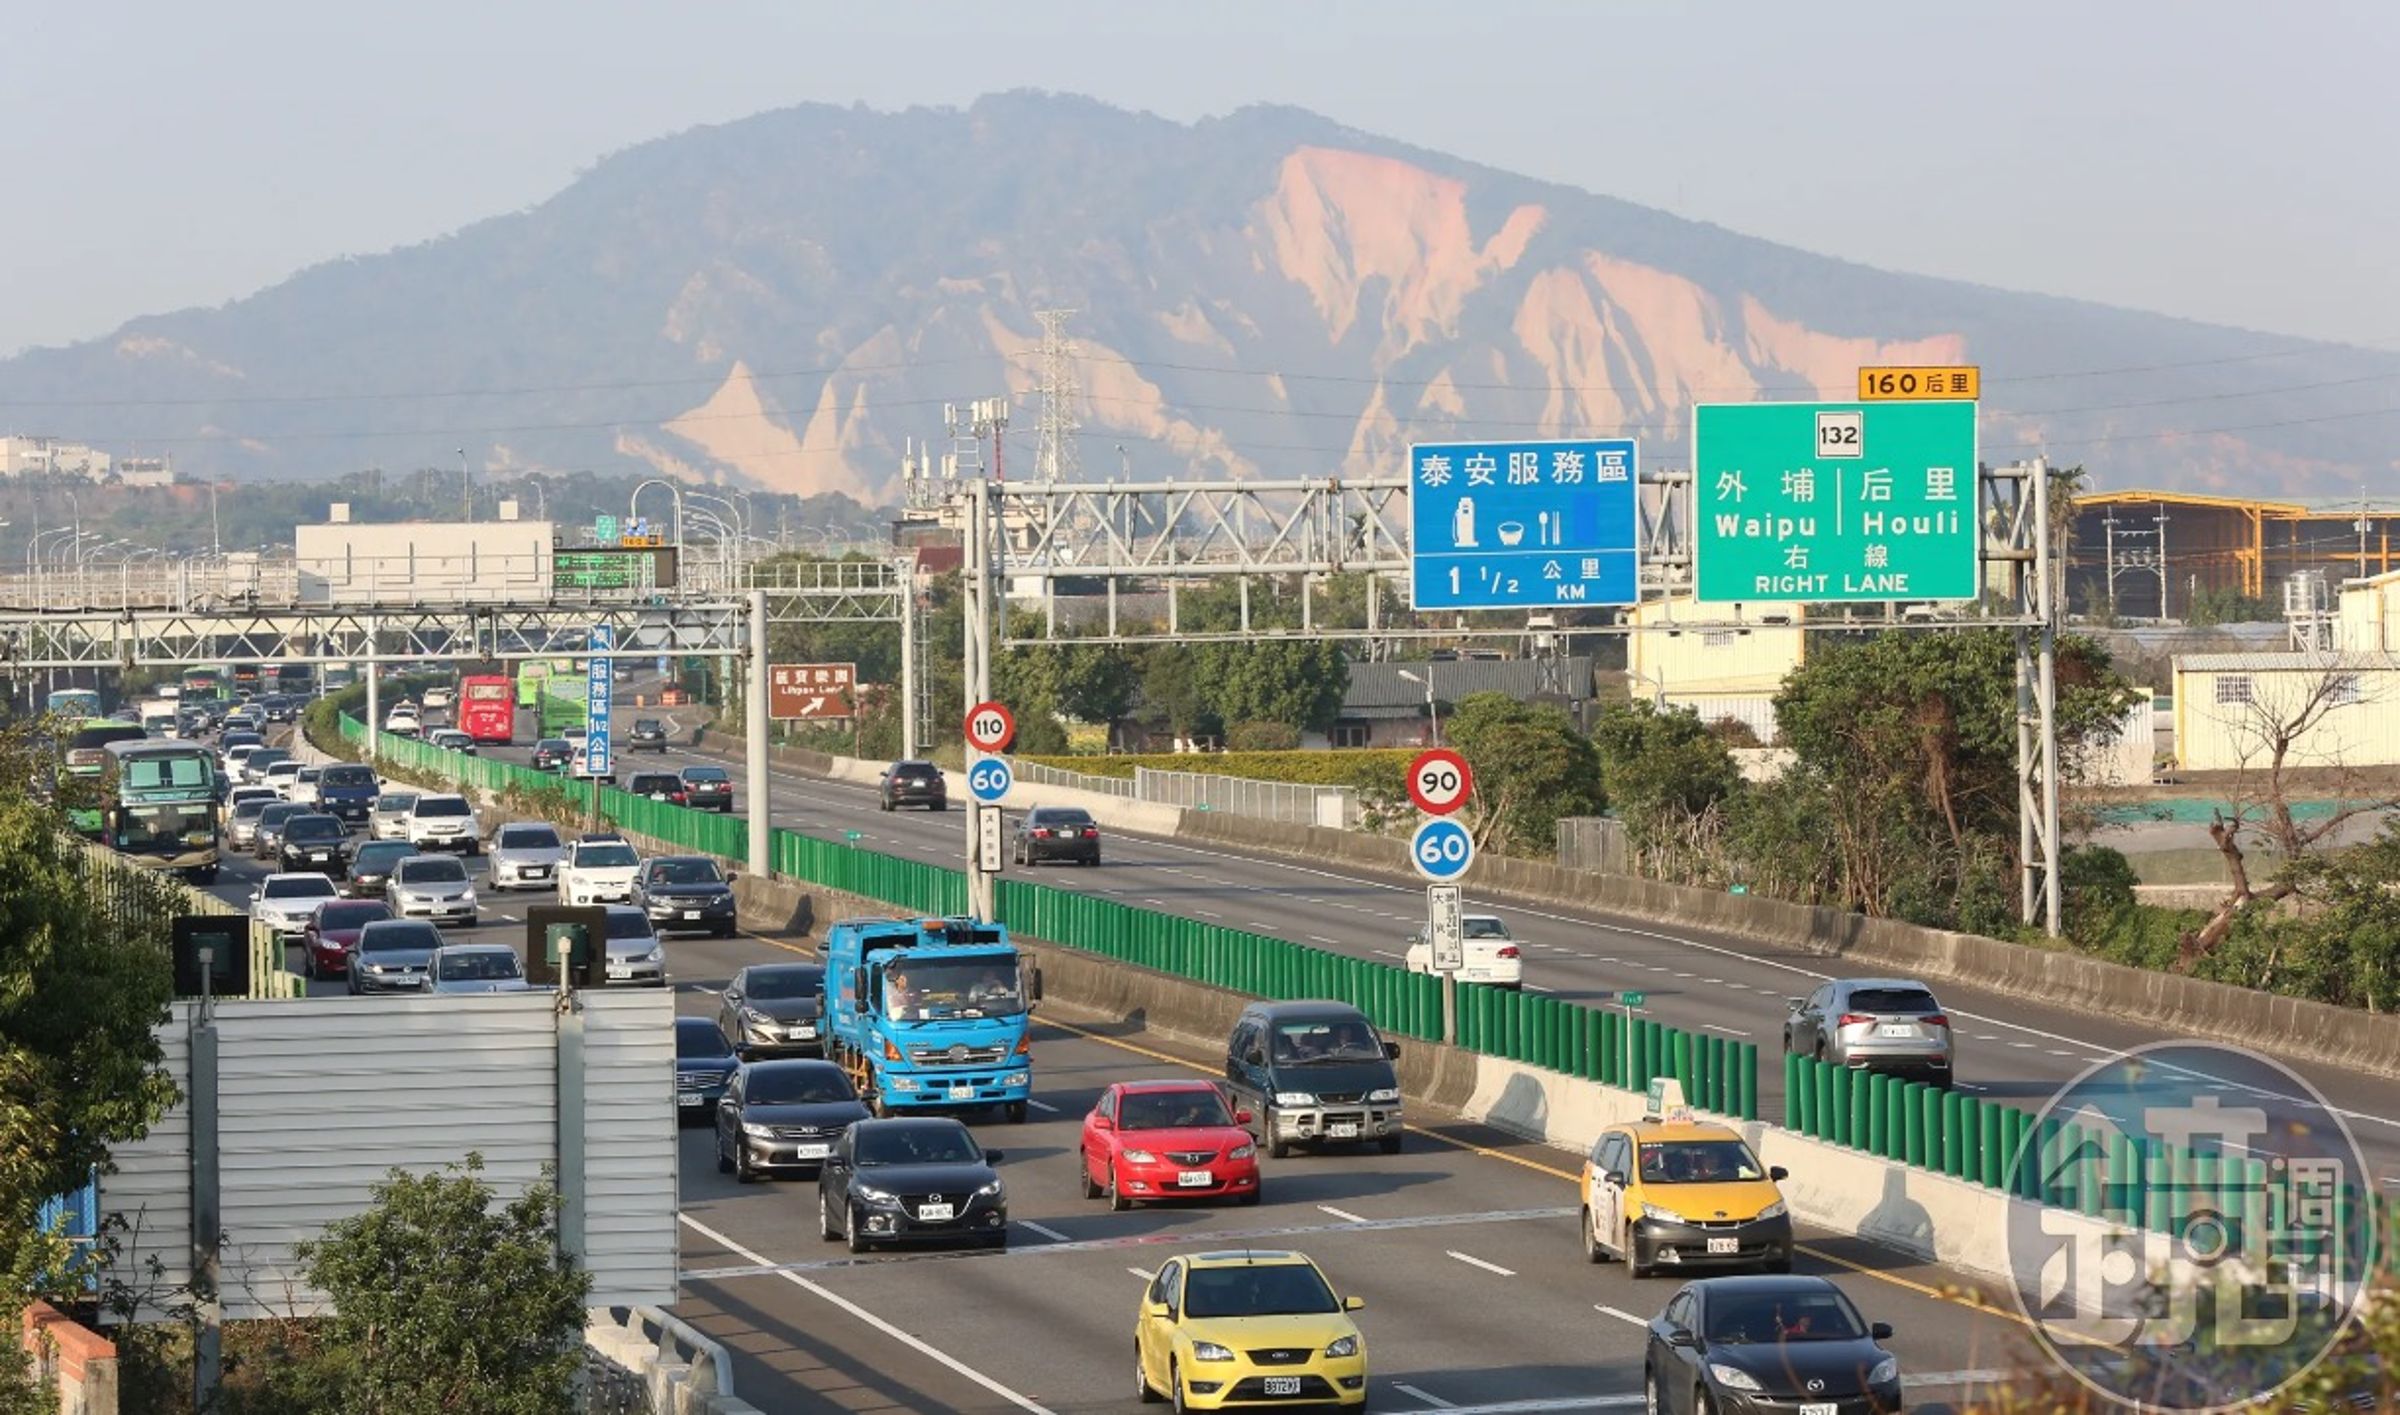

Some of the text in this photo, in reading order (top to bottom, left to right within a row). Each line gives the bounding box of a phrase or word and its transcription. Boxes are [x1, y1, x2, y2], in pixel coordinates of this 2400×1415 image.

[1867, 373, 1969, 395] 160 后里
[1820, 426, 1858, 445] 132
[1420, 450, 1629, 487] 泰安服務區
[1715, 467, 1957, 502] 外埔 后里
[1715, 510, 1958, 541] Waipu Houli
[1543, 558, 1601, 580] 公里
[1556, 584, 1585, 600] KM
[1755, 573, 1909, 593] RIGHT LANE
[975, 718, 1003, 736] 110
[972, 769, 1007, 790] 60
[1422, 771, 1457, 794] 90
[1419, 834, 1466, 864] 60
